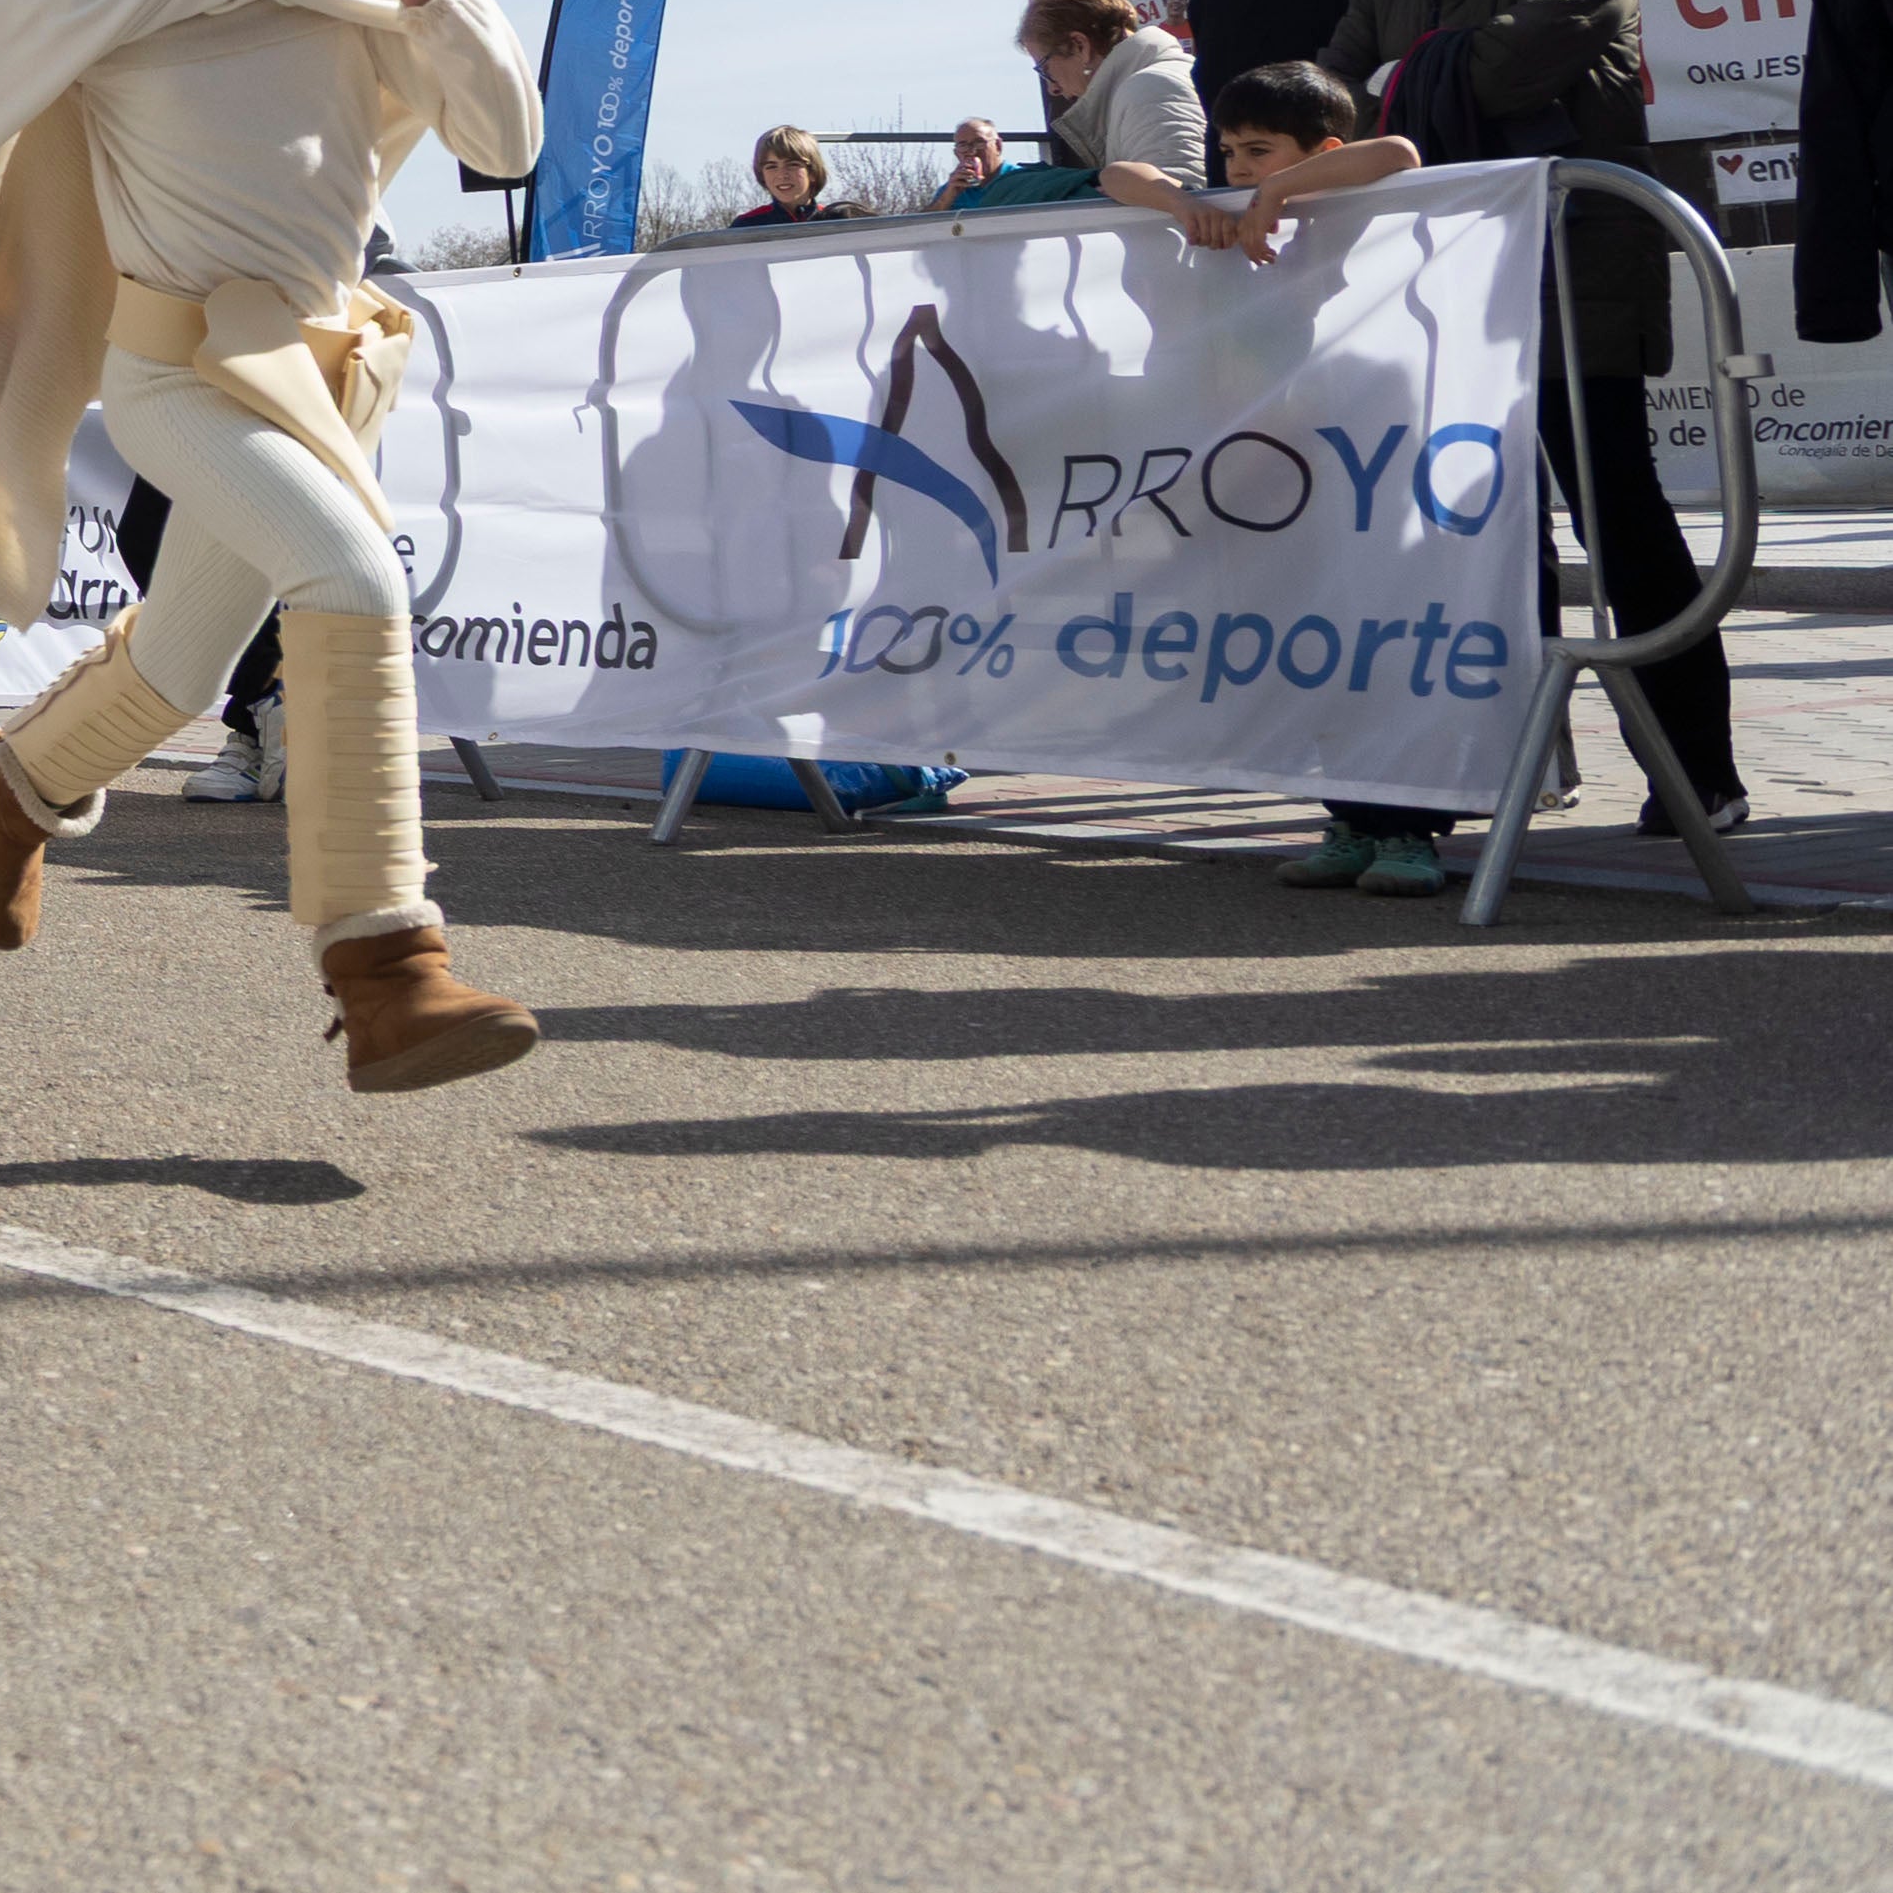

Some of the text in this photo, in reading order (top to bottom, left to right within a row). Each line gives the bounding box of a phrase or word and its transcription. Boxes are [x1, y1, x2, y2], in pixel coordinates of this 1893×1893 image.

[1687, 54, 1806, 85] ONG JES
[597, 75, 625, 130] 100%
[1747, 153, 1800, 183] ent
[1771, 383, 1806, 408] de
[839, 304, 1505, 563] ARROYO
[1668, 419, 1707, 447] de
[1851, 443, 1872, 458] de
[411, 601, 658, 672] comienda
[817, 592, 1511, 703] 100% deporte
